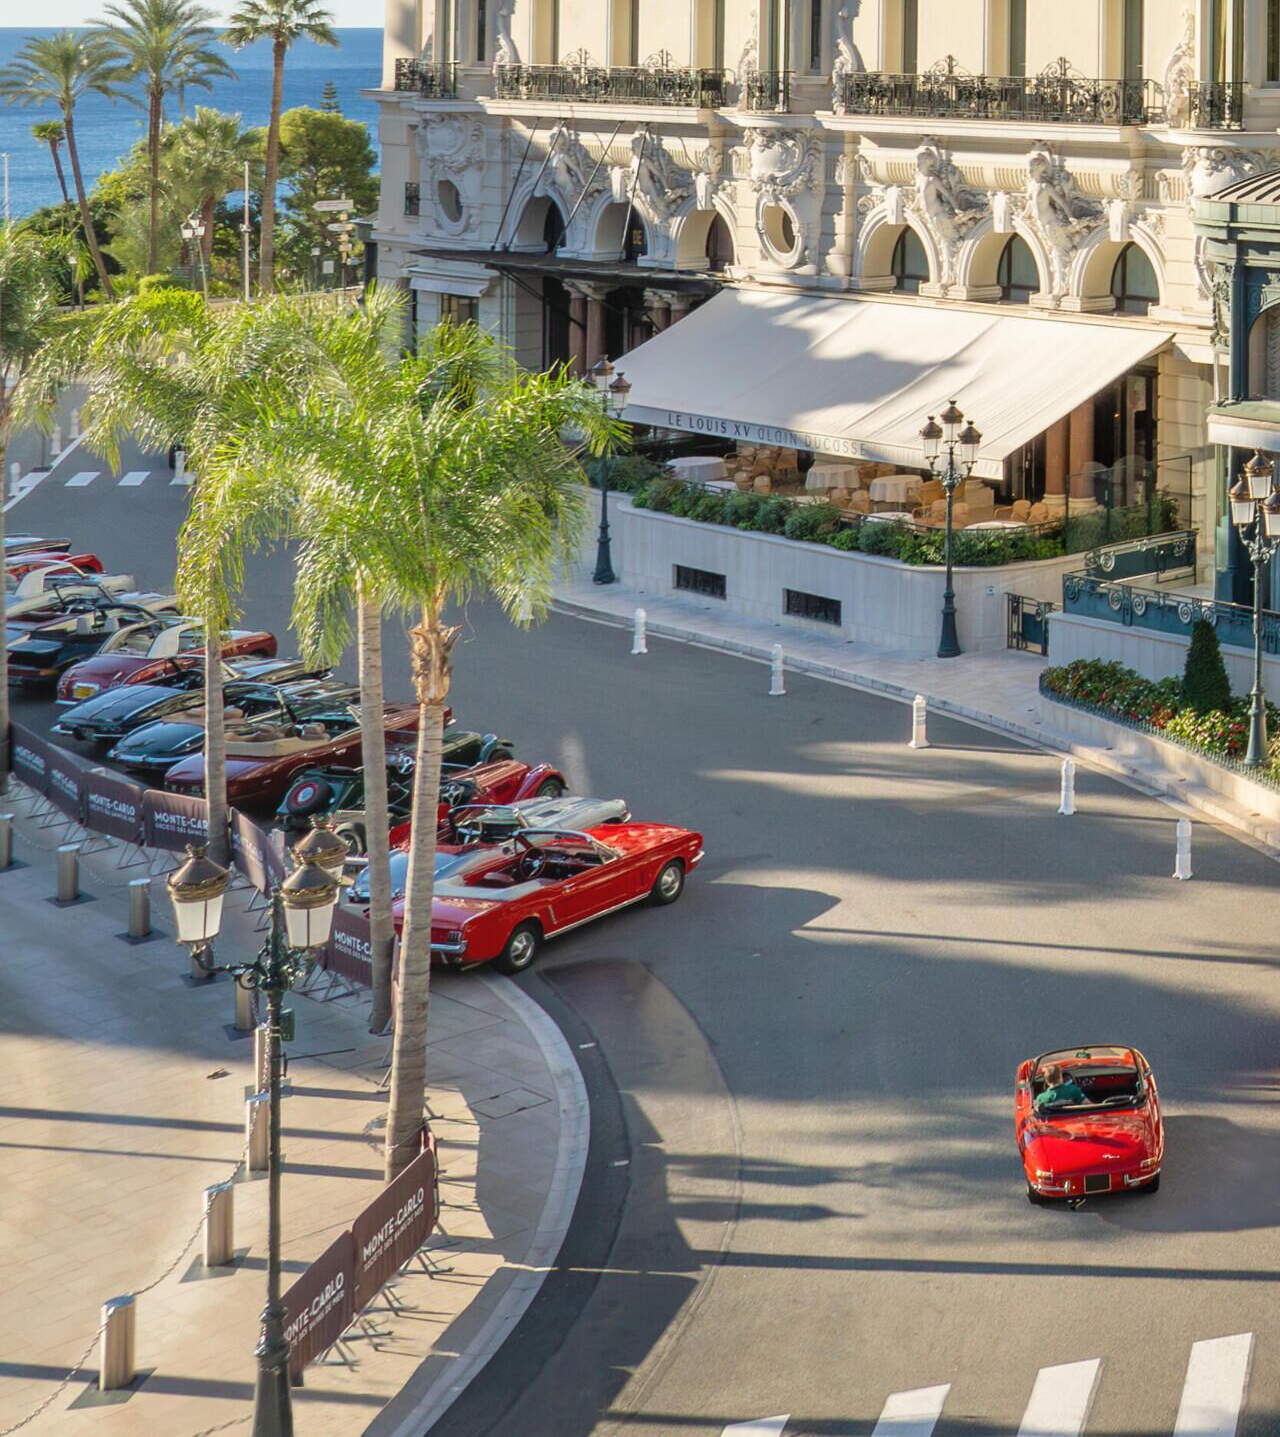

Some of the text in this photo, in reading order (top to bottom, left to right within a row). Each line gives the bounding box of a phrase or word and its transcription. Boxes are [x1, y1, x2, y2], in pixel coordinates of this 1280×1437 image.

[668, 411, 683, 427] LE
[689, 415, 728, 434] LOUIS
[734, 421, 751, 438] XV
[88, 793, 136, 816] MONTE-CARLO
[154, 810, 208, 831] MONTE-CAR
[334, 929, 373, 956] MONTE-CA
[363, 1186, 424, 1262] MONTE-CARLO
